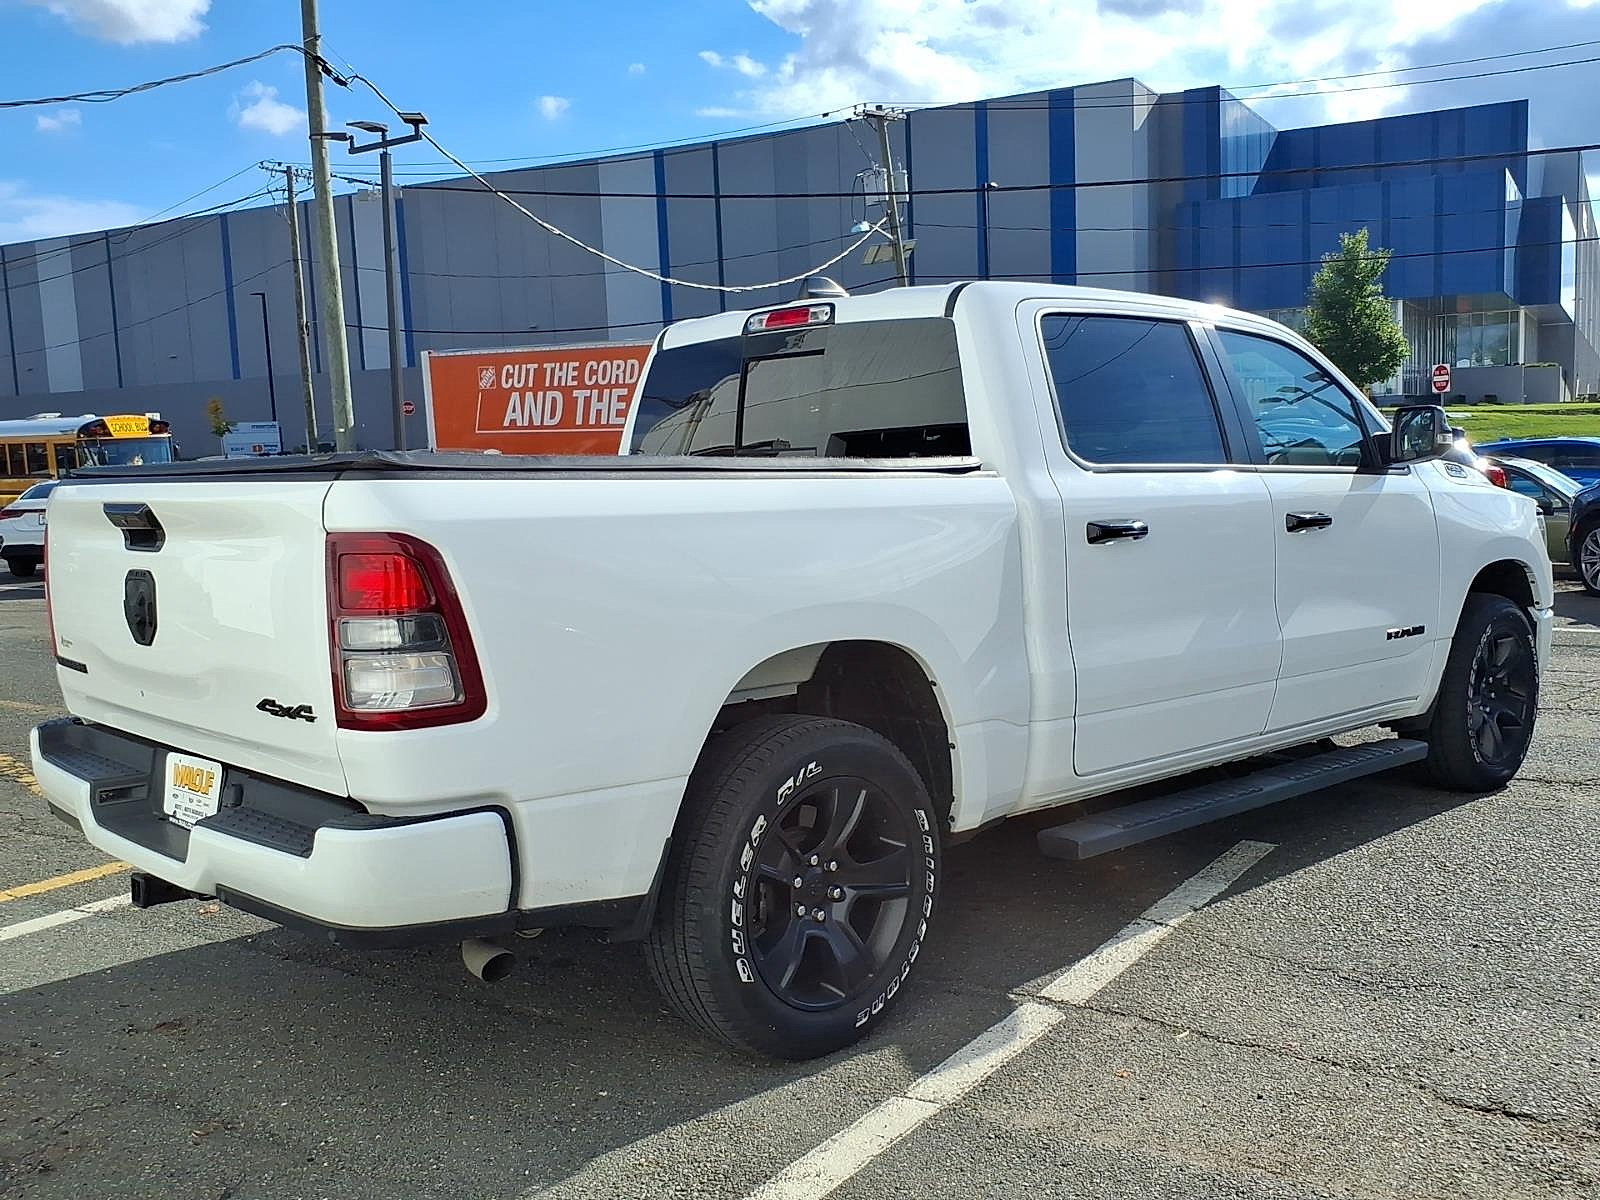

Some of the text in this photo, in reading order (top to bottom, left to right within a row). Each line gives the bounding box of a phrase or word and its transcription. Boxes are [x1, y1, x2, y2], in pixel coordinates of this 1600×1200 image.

[501, 363, 539, 389] CUT
[543, 361, 580, 387] THE
[584, 359, 640, 386] CORD
[503, 388, 628, 427] AND THE
[111, 421, 148, 433] SCHOOL BUS
[1386, 625, 1425, 640] RAM
[731, 814, 768, 982] DUELER
[855, 808, 935, 1028] BRIDGESTONE
